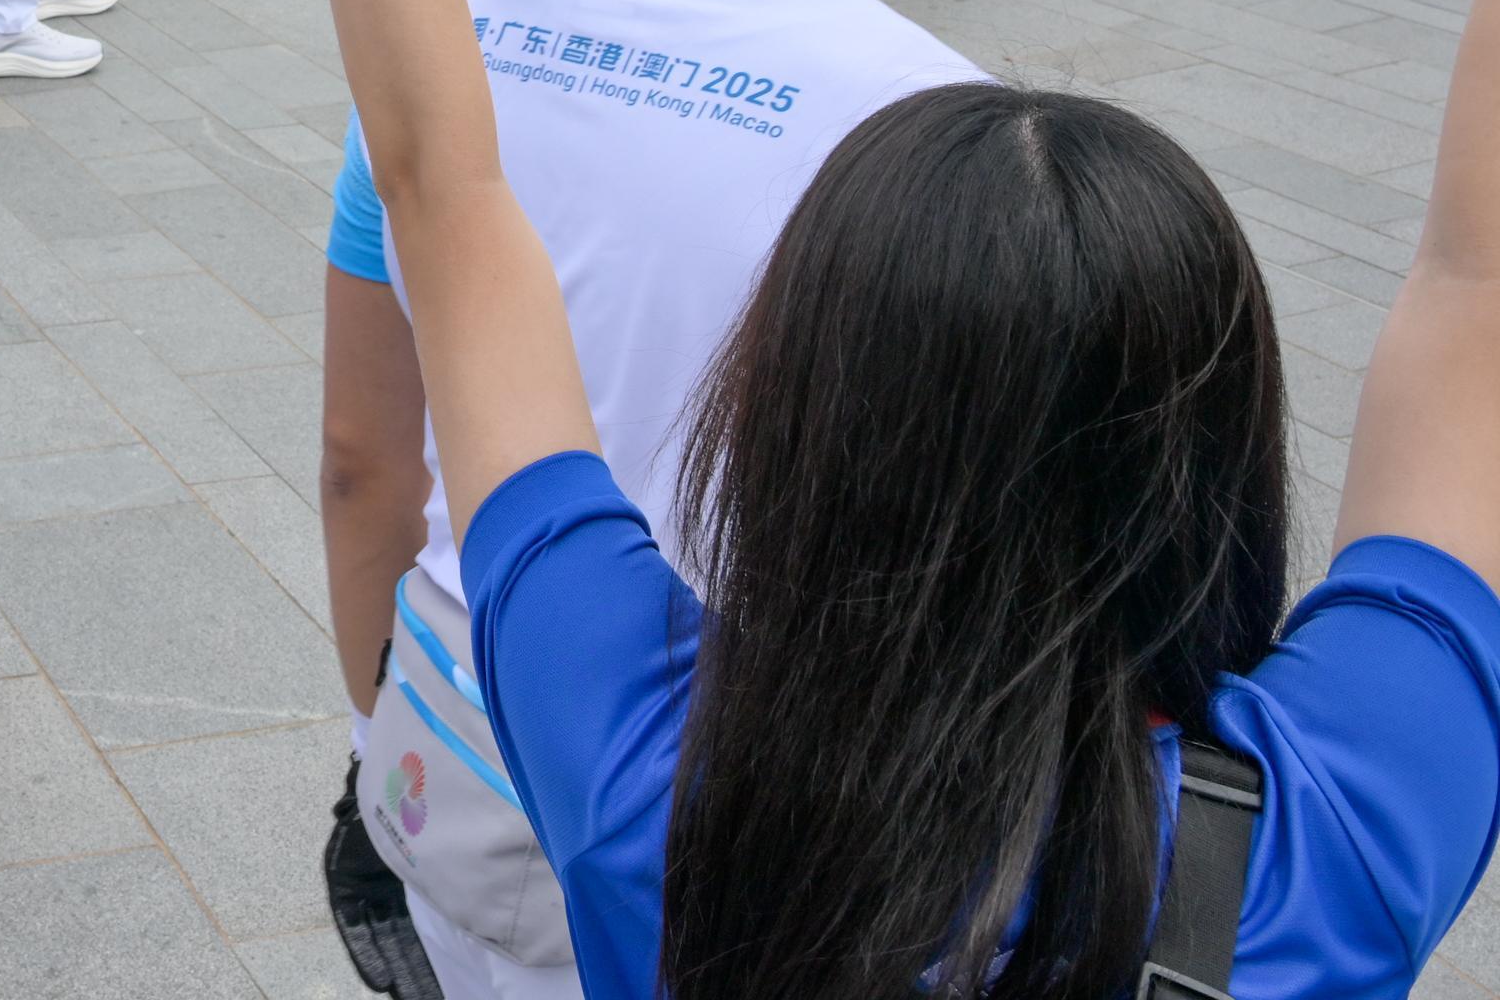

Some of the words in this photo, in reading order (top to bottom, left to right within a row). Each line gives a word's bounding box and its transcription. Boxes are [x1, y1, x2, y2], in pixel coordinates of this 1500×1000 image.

[591, 76, 640, 106] Hong
[644, 89, 694, 118] Kong
[709, 103, 785, 139] Macao
[702, 66, 801, 113] 2025
